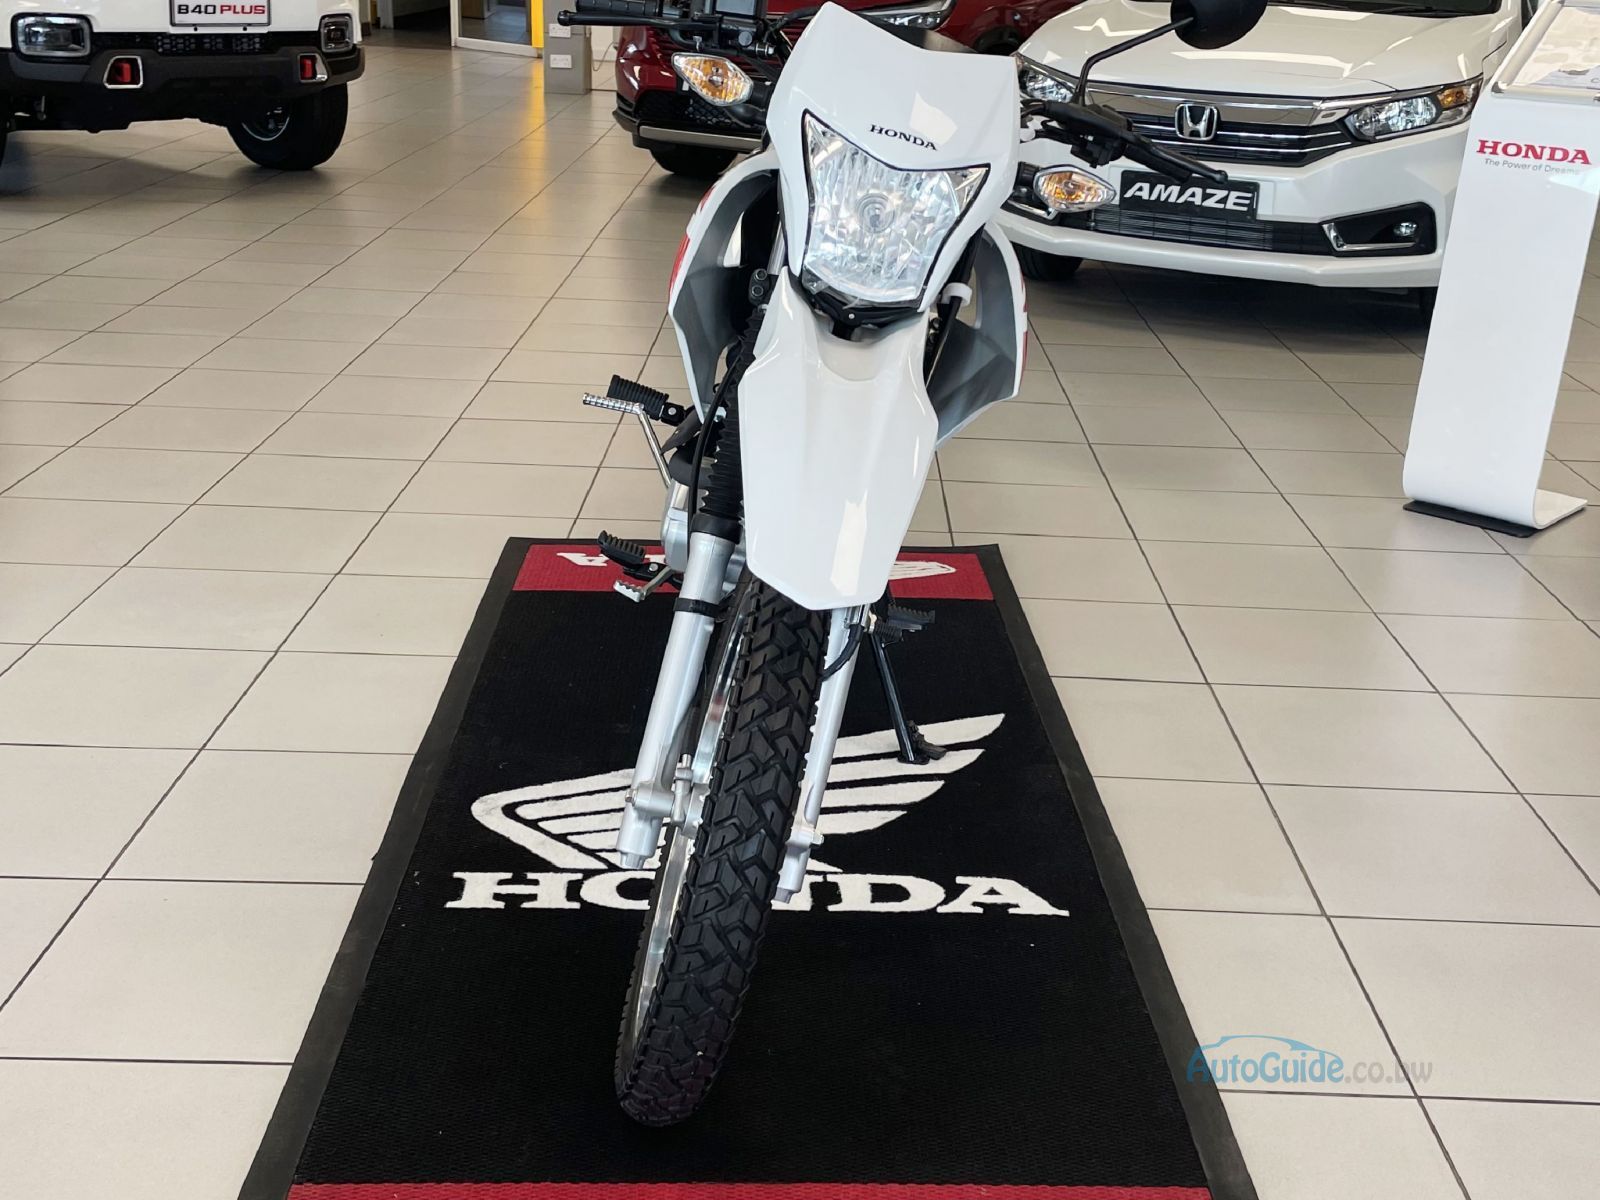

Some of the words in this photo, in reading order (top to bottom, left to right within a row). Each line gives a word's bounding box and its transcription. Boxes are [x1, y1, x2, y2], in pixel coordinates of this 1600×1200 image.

[177, 4, 217, 15] B40
[220, 4, 266, 15] PLUS
[869, 124, 938, 151] HONDA
[1476, 139, 1592, 165] HONDA
[1484, 157, 1500, 167] The
[1501, 159, 1531, 170] Power
[1531, 163, 1543, 172] of
[1124, 182, 1253, 211] AMAZE
